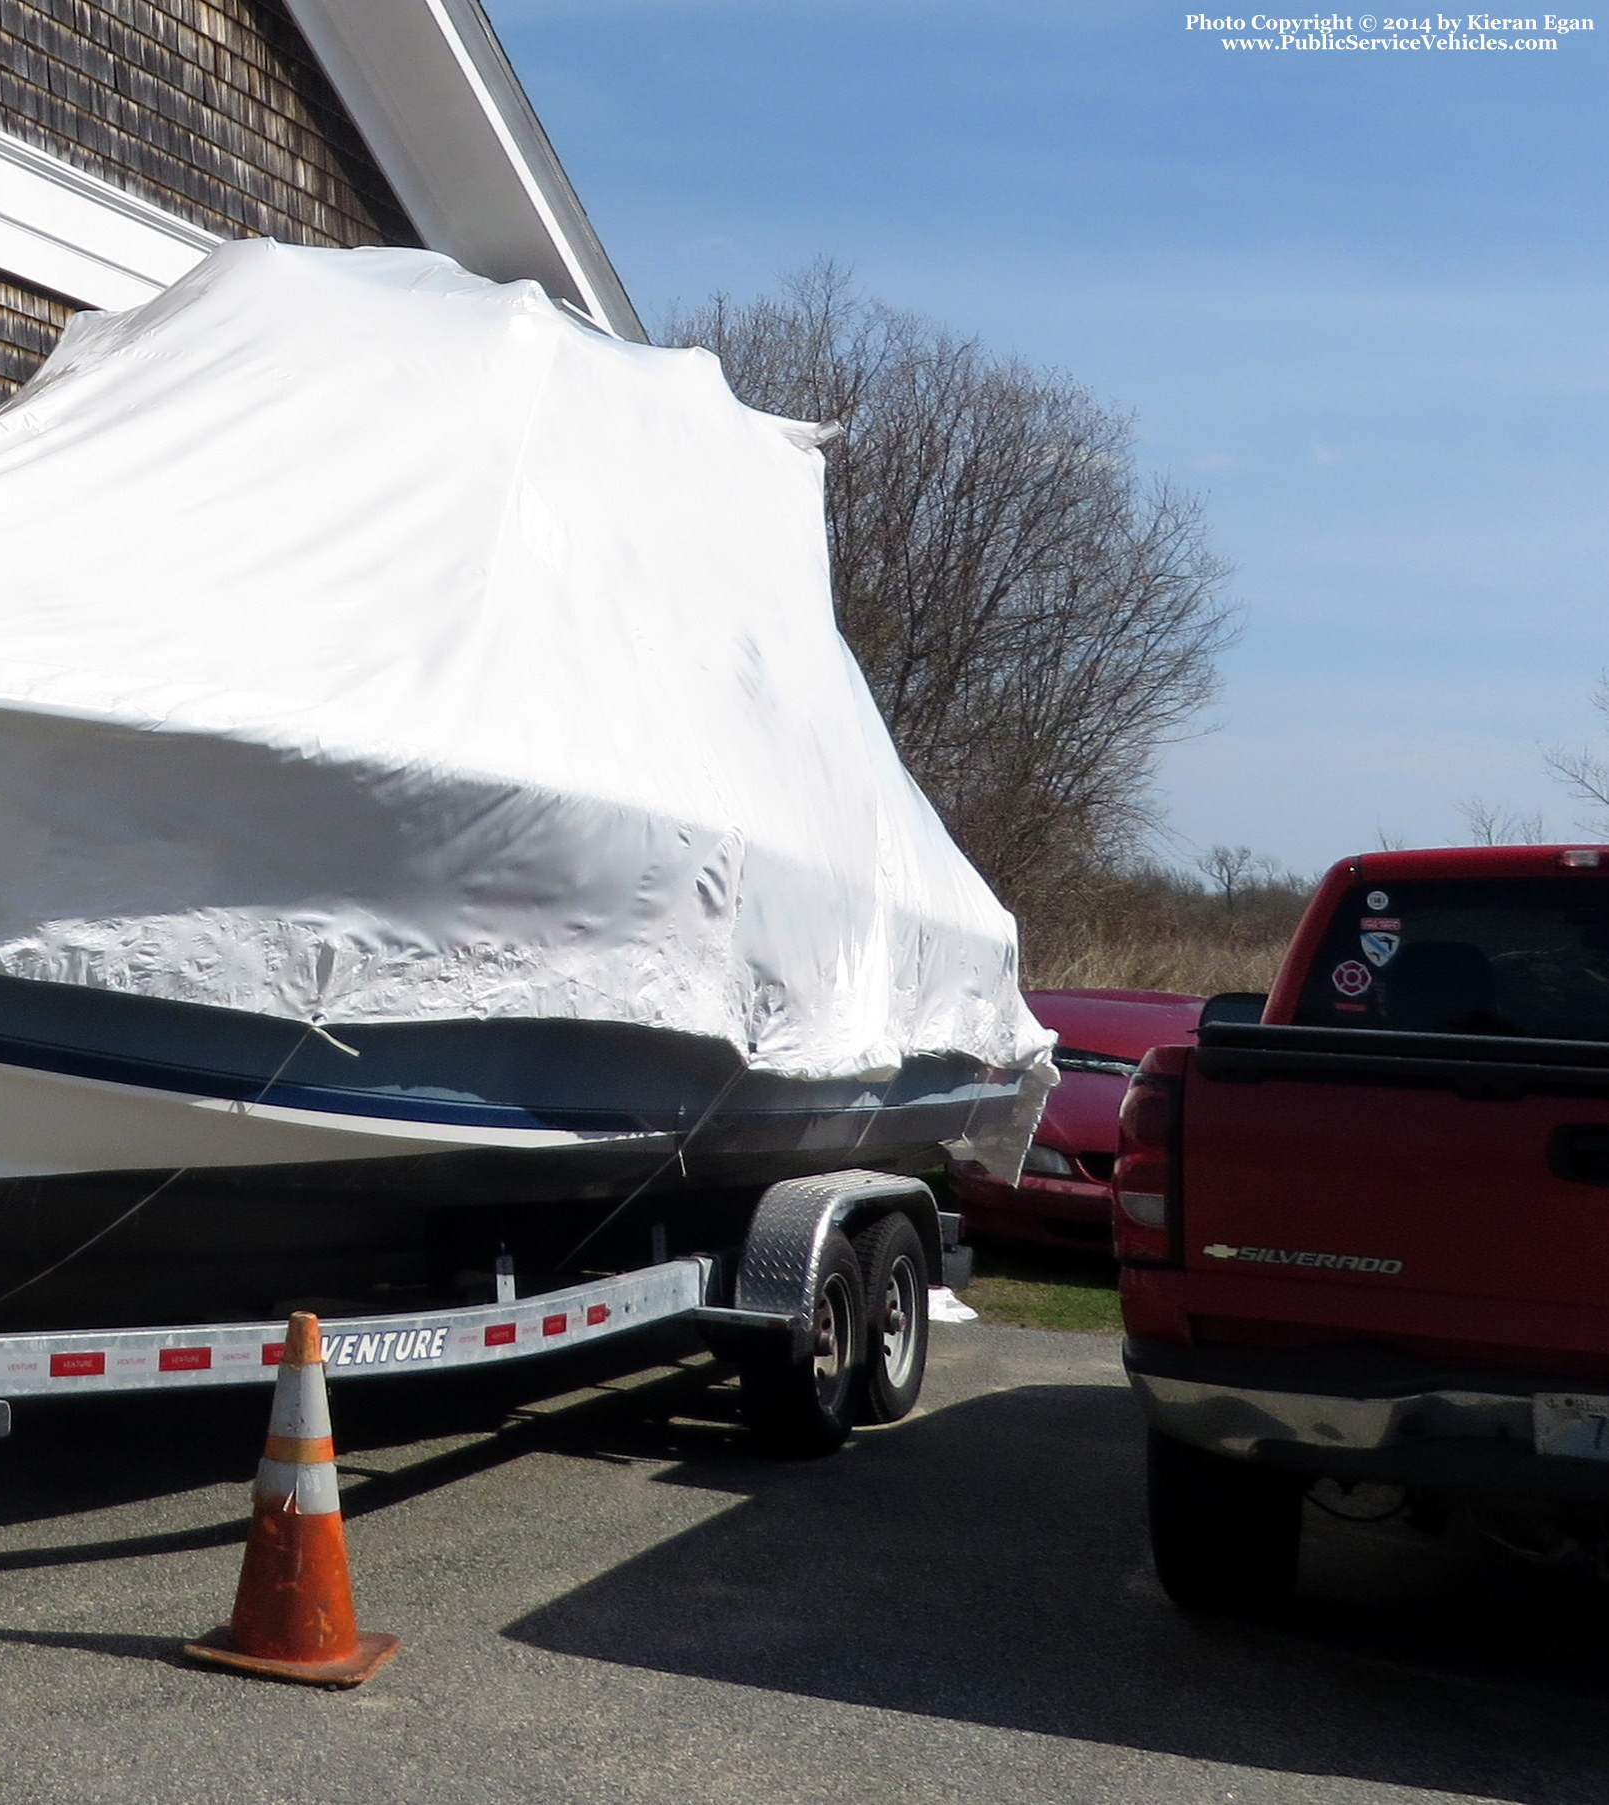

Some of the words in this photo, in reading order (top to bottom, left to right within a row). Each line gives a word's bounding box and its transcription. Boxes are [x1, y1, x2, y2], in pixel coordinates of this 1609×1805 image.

[1238, 1246, 1403, 1275] SILVERADO
[320, 1326, 451, 1366] VENTURE
[117, 1358, 147, 1366] VENTURE
[171, 1355, 200, 1364] VENTURE
[7, 1362, 38, 1372] VENTURE
[62, 1360, 93, 1369] VENTURE
